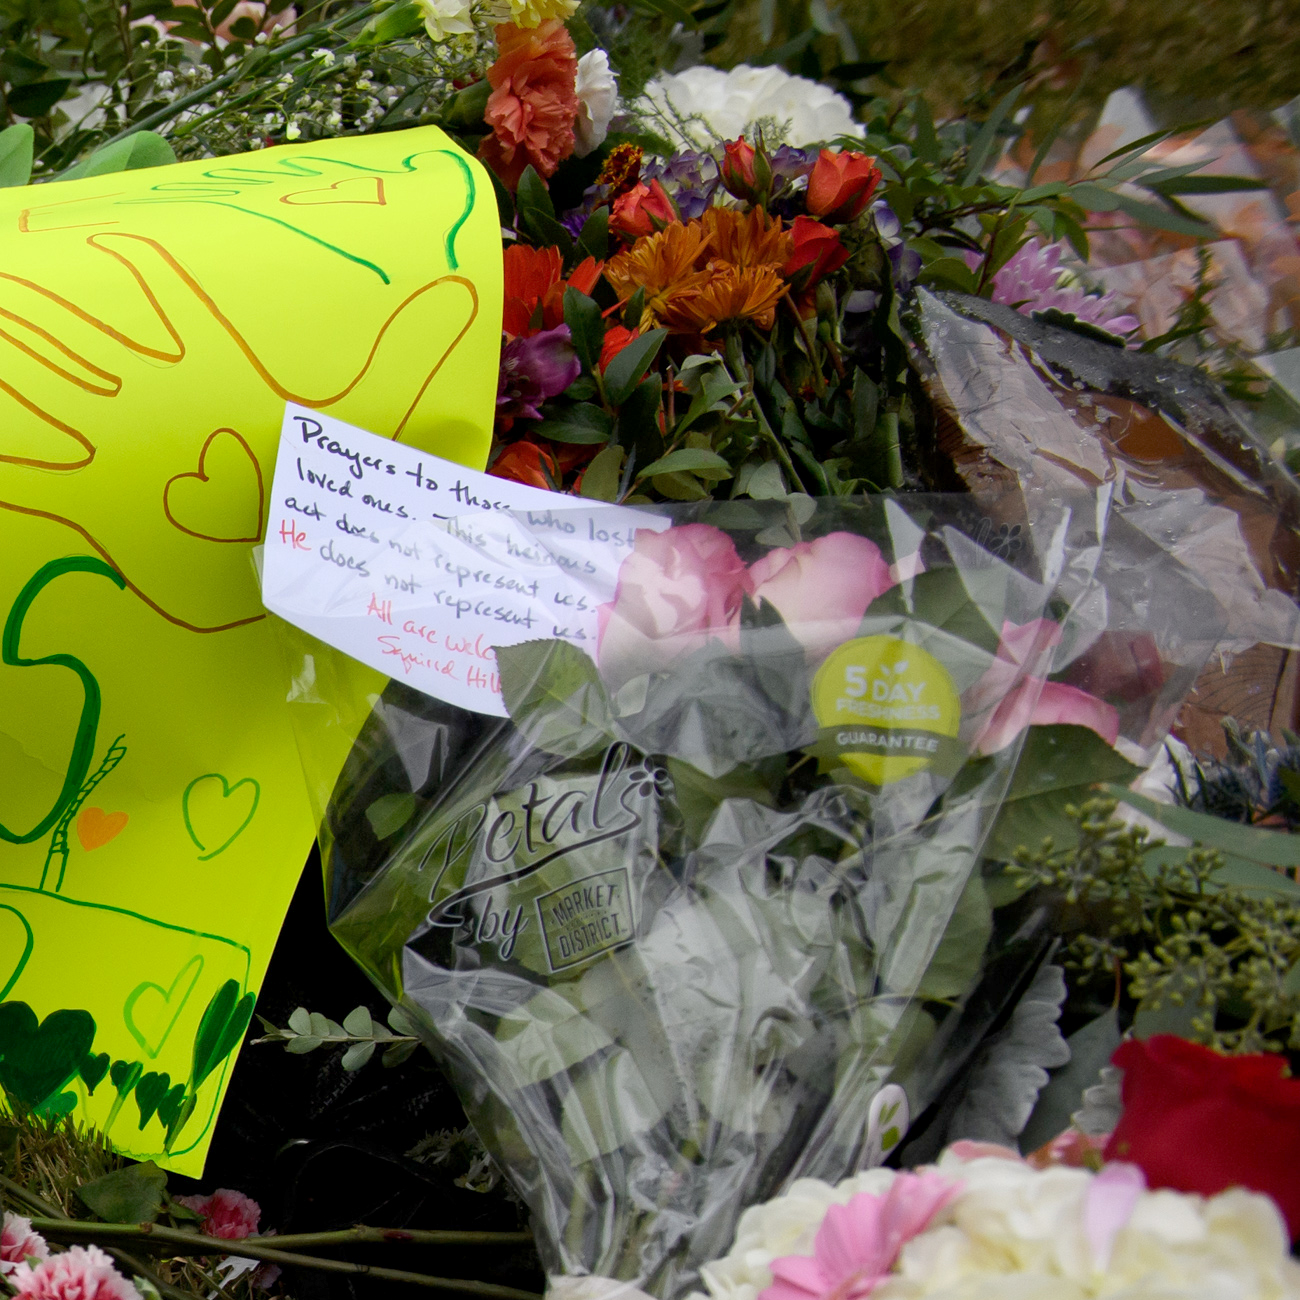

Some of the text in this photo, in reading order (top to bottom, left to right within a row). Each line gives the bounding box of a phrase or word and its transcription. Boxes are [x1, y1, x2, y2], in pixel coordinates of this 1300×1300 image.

[293, 415, 396, 480] Prayers
[405, 462, 439, 491] to
[526, 509, 576, 535] who
[588, 517, 636, 549] lost
[296, 456, 354, 499] loved
[506, 533, 597, 575] heinous
[278, 518, 312, 552] He
[319, 538, 371, 578] does
[384, 573, 423, 596] not
[433, 589, 540, 630] represent
[284, 496, 327, 522] act
[335, 513, 380, 545] does
[388, 538, 421, 561] not
[433, 553, 540, 599] represent
[367, 591, 394, 626] All
[402, 619, 438, 645] are
[465, 664, 502, 694] Hill
[844, 664, 927, 703] 5 DAY
[835, 697, 942, 721] FRESHNESS
[836, 731, 941, 753] GUARANTEE
[418, 740, 644, 902] Petals
[476, 890, 530, 963] by
[551, 884, 618, 927] MARKET
[558, 912, 620, 959] DISTRICT
